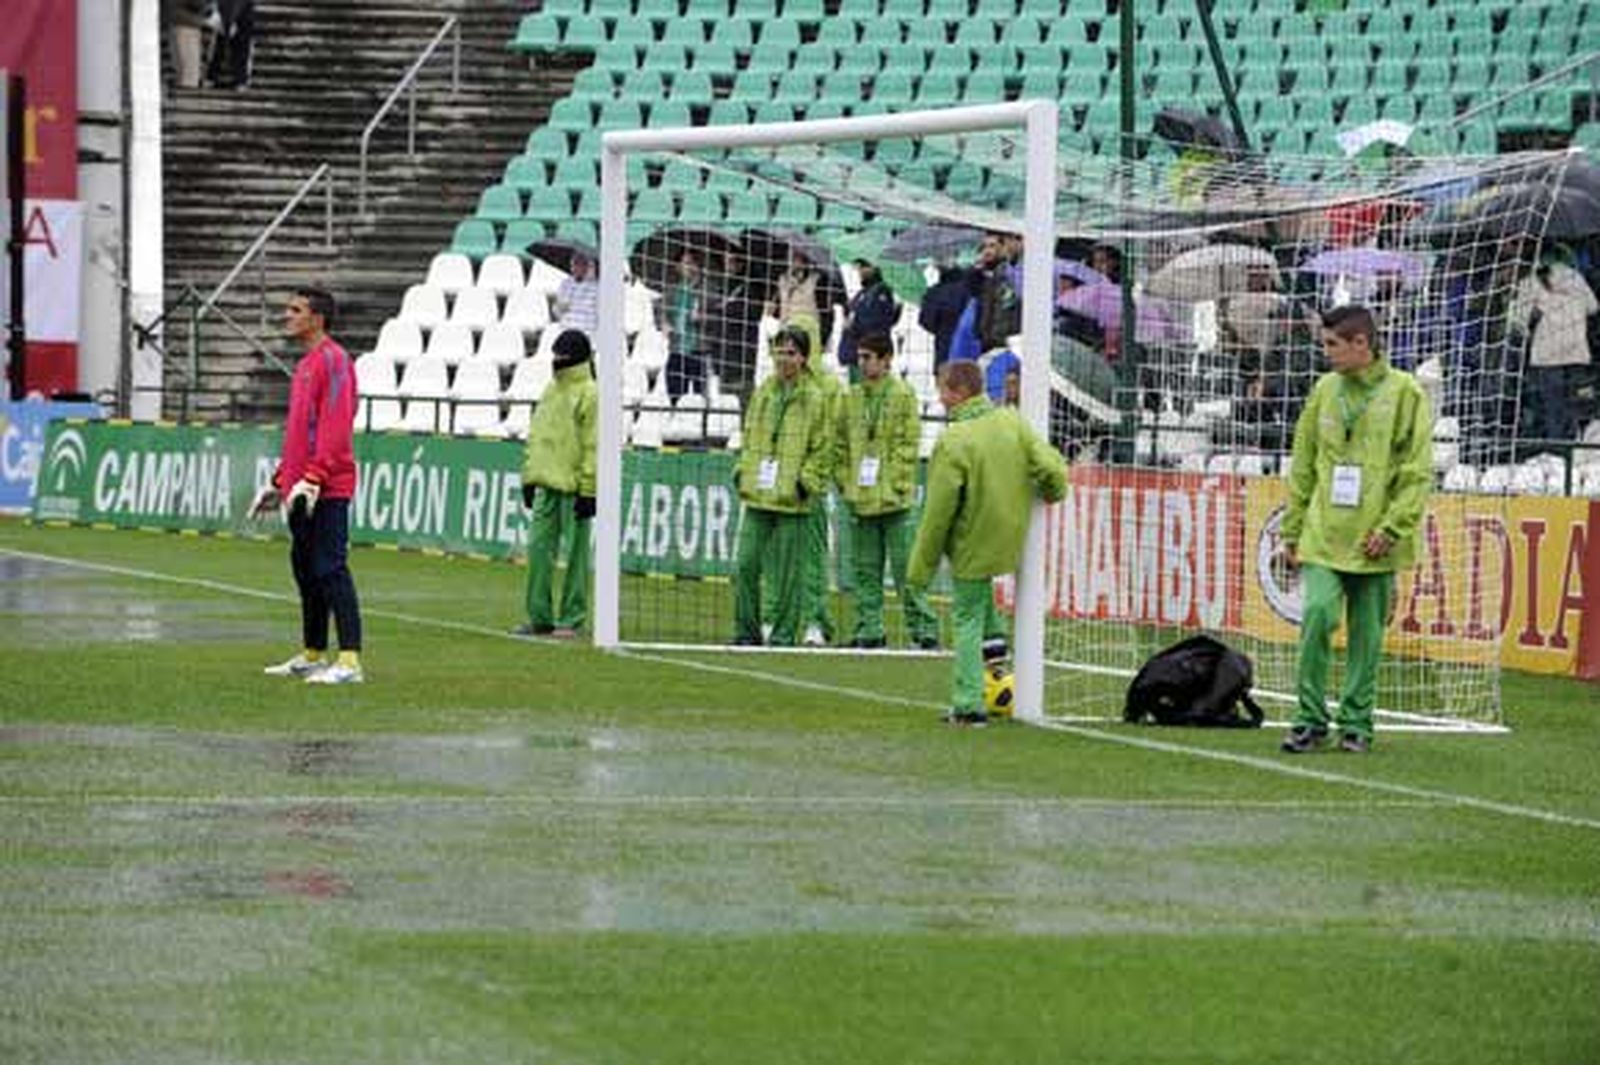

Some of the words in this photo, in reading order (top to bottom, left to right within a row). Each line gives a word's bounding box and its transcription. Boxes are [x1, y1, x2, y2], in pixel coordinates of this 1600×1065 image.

[94, 436, 232, 519] CAMPAÑA
[256, 445, 450, 536] PNCIÓN
[590, 481, 747, 561] ABOR
[1388, 512, 1588, 650] ADIA
